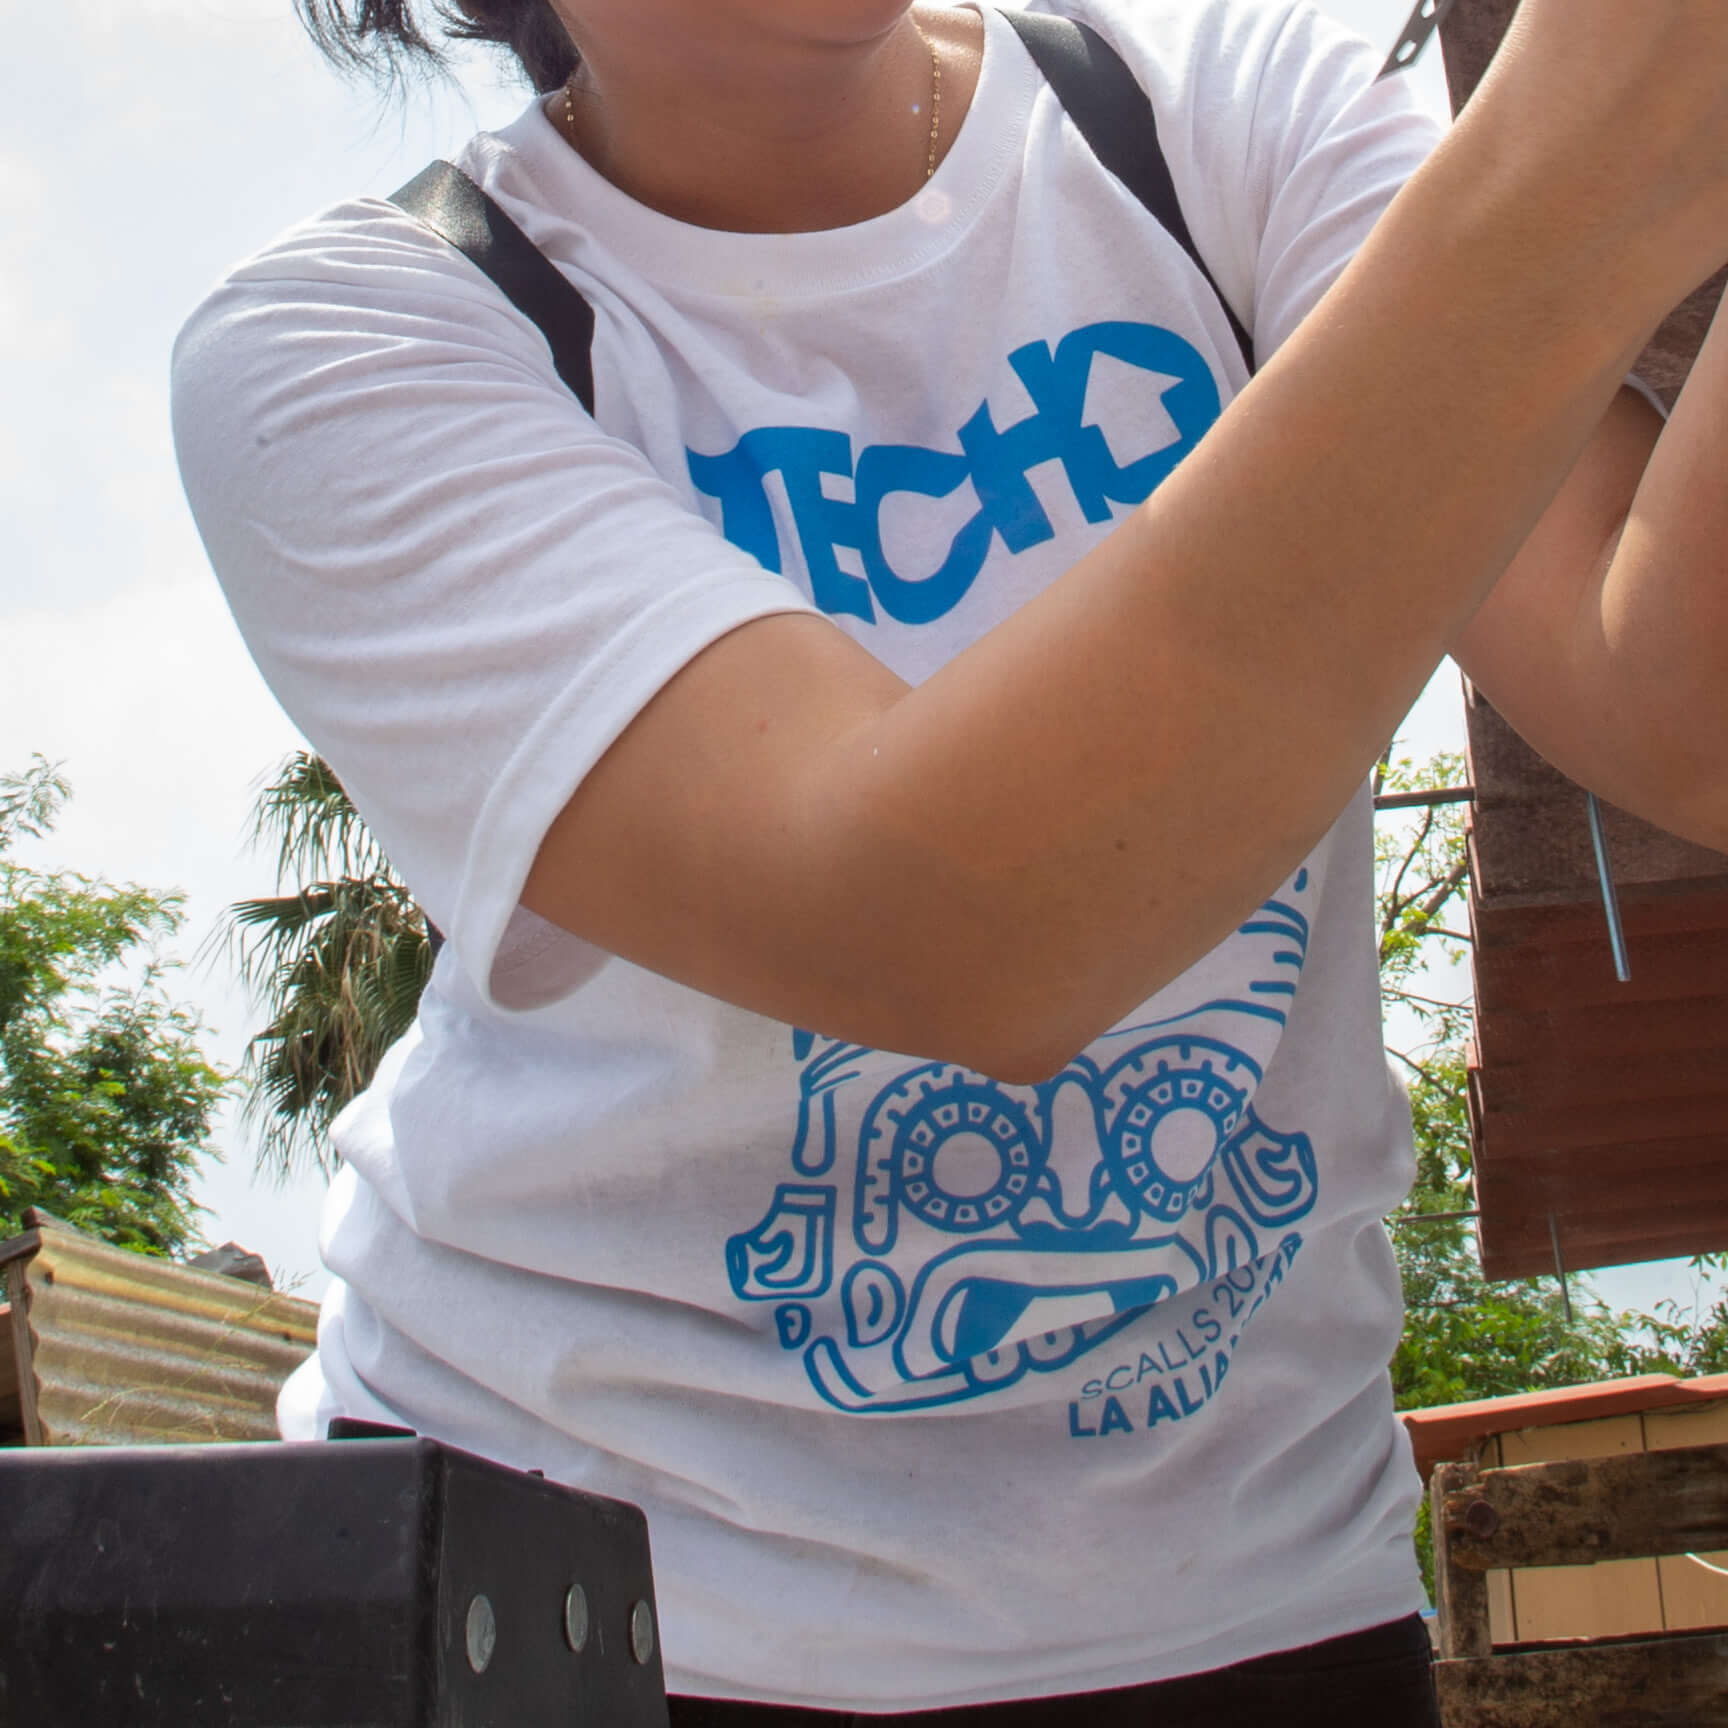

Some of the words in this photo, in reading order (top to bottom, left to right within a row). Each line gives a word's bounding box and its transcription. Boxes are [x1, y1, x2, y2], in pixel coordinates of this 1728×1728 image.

[685, 320, 1221, 625] TECHO
[1081, 1308, 1222, 1400] SCALLS
[1068, 1395, 1134, 1437] LA
